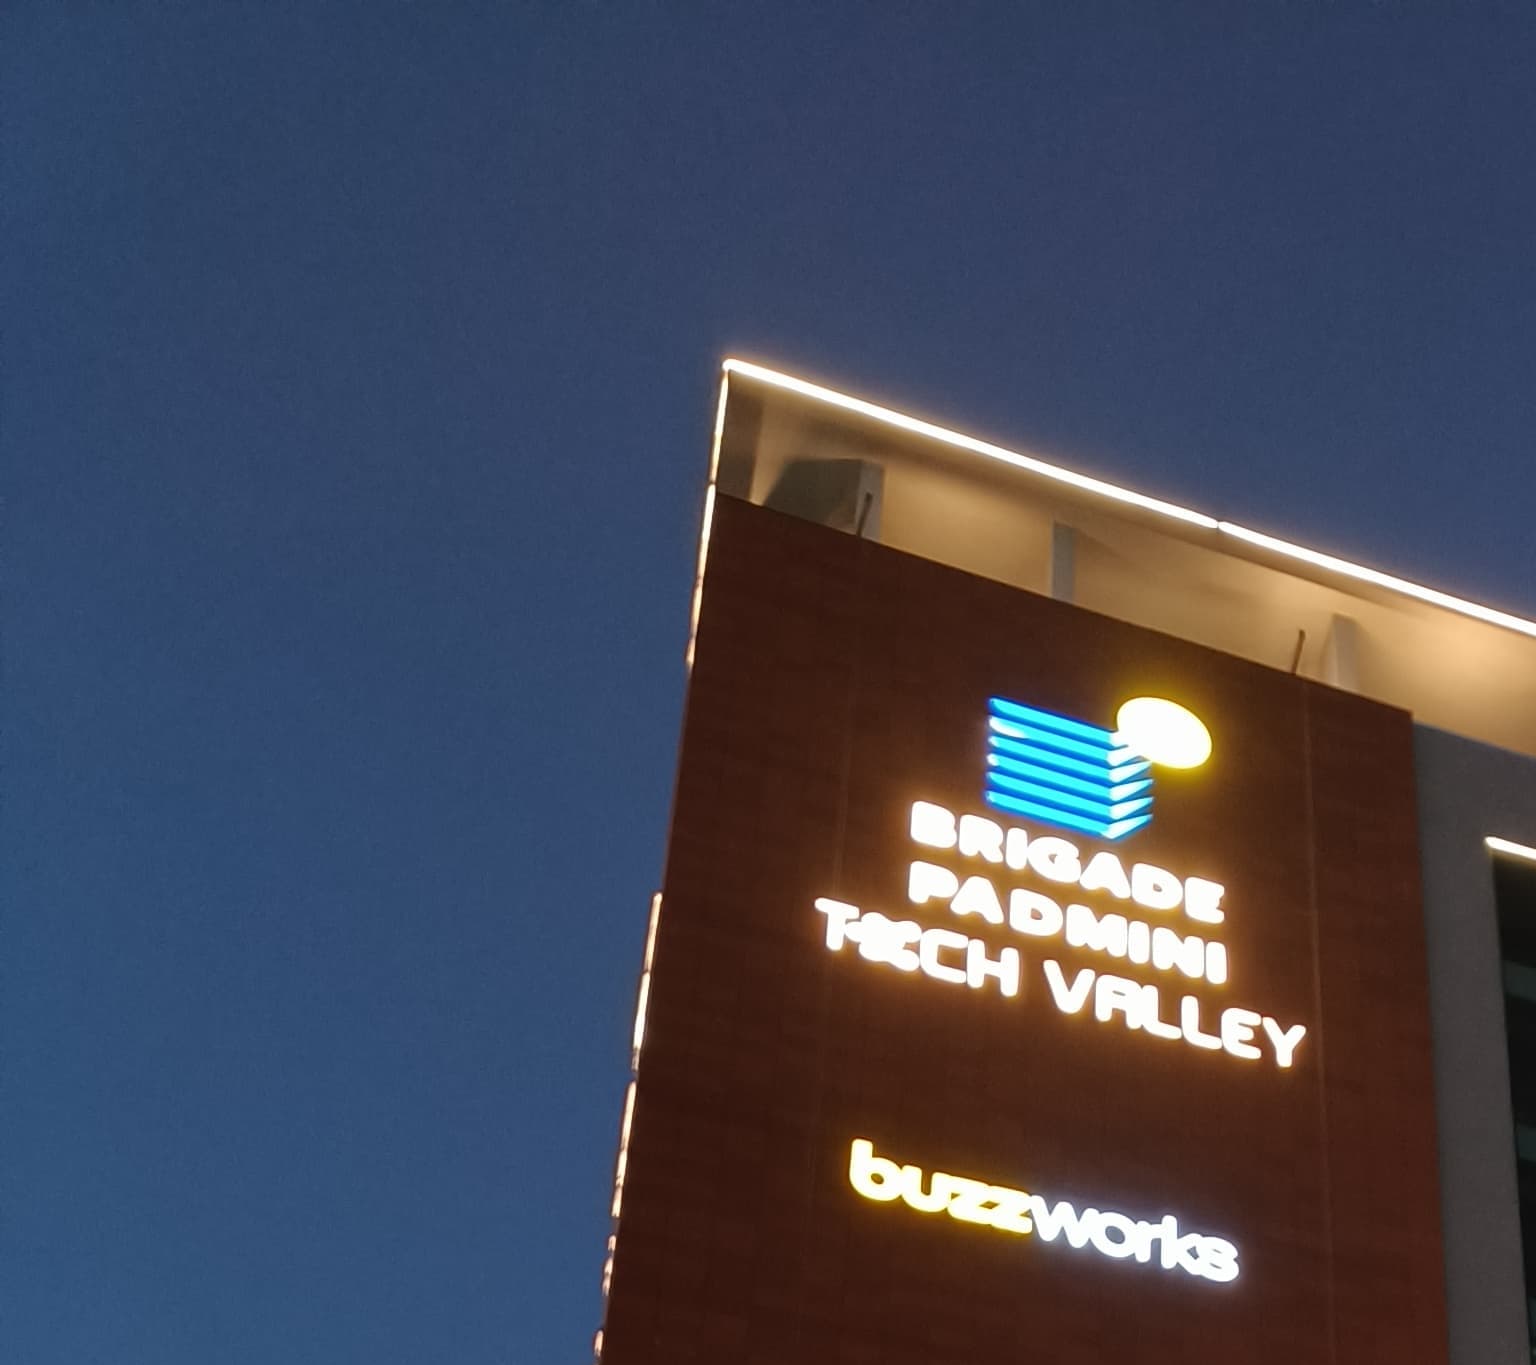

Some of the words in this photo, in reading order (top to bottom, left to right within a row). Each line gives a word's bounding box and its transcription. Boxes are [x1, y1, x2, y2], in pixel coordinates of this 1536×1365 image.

[908, 861, 1228, 986] PADMINI
[910, 801, 1226, 926] BRIGADE
[1043, 959, 1307, 1068] VALLEY
[849, 1139, 1240, 1283] buzzworks
